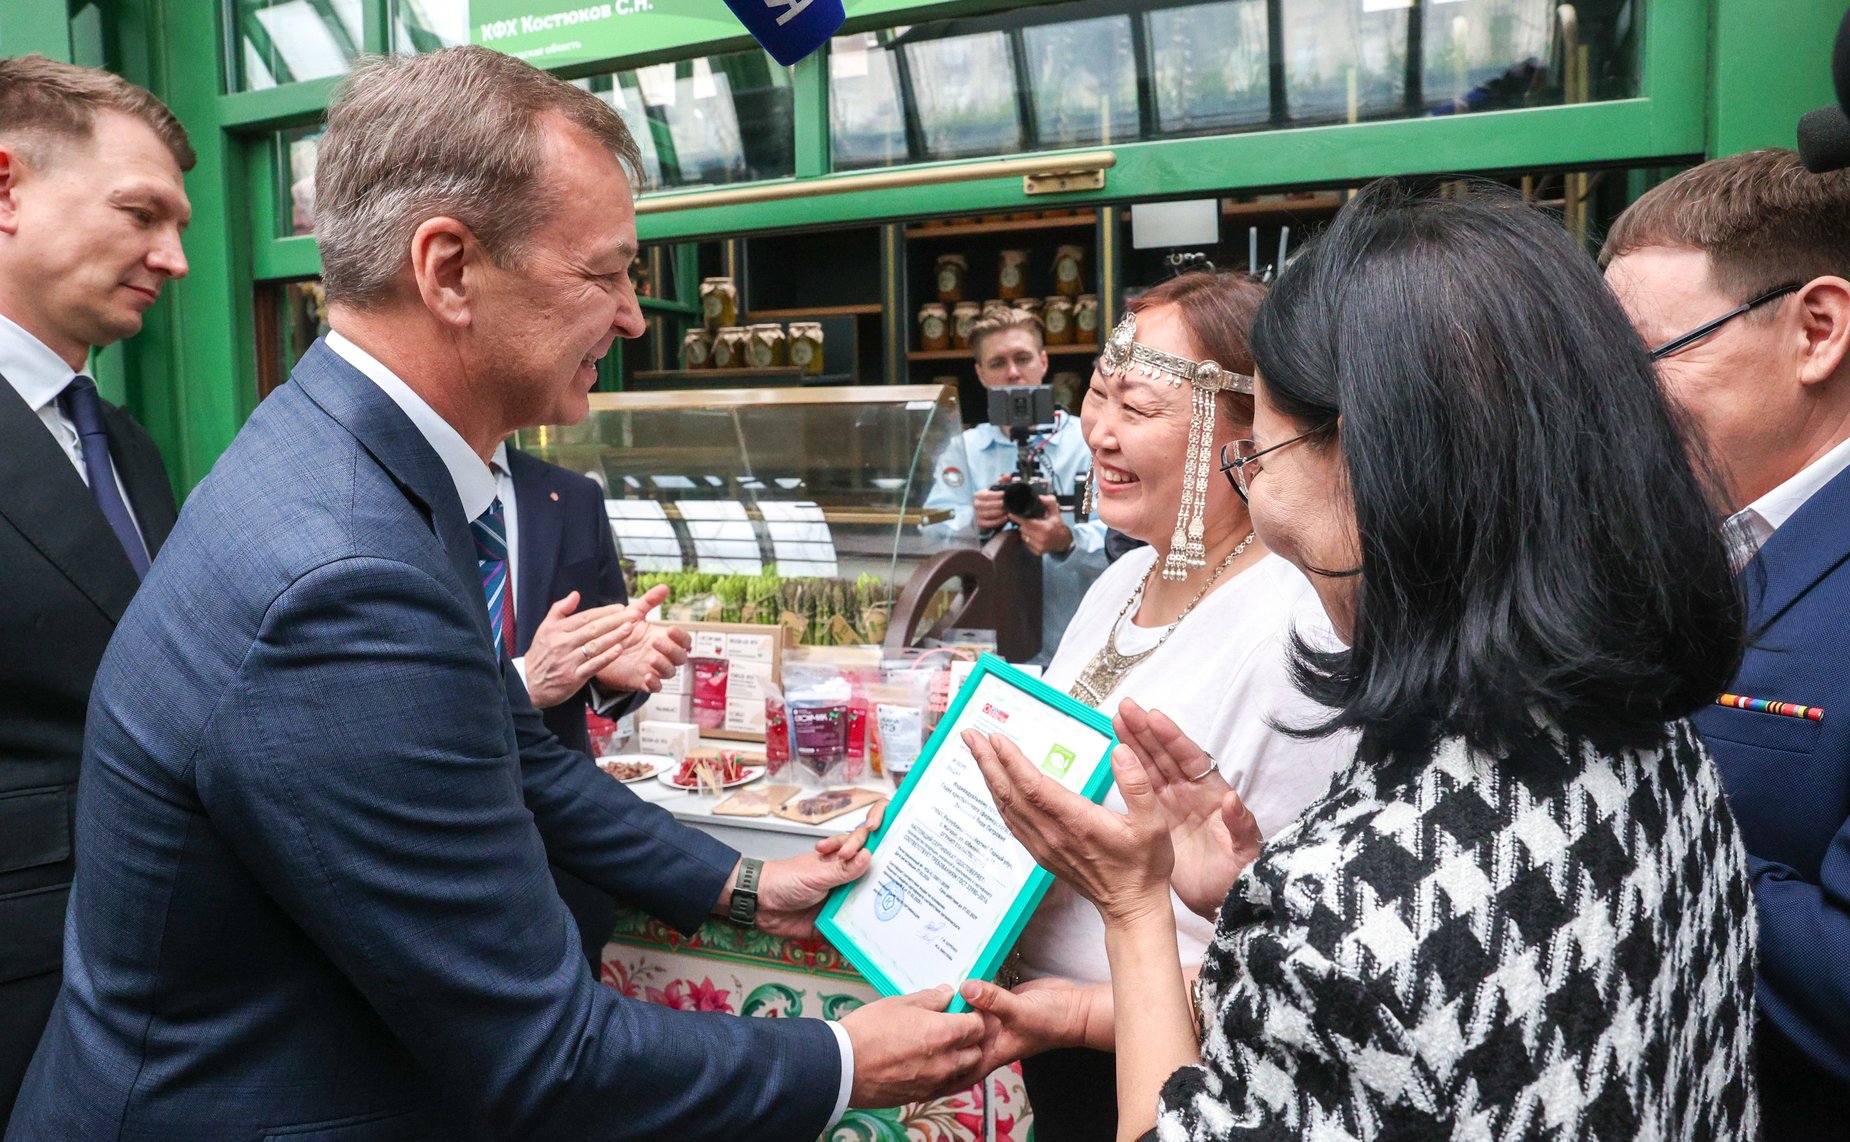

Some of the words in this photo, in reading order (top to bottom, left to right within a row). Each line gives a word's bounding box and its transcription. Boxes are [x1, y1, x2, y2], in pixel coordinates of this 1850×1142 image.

[480, 18, 518, 42] КФХ
[521, 4, 613, 34] Костюков
[931, 839, 957, 860] СЕРТИФИКАТ
[956, 875, 968, 887] ГОСТ
